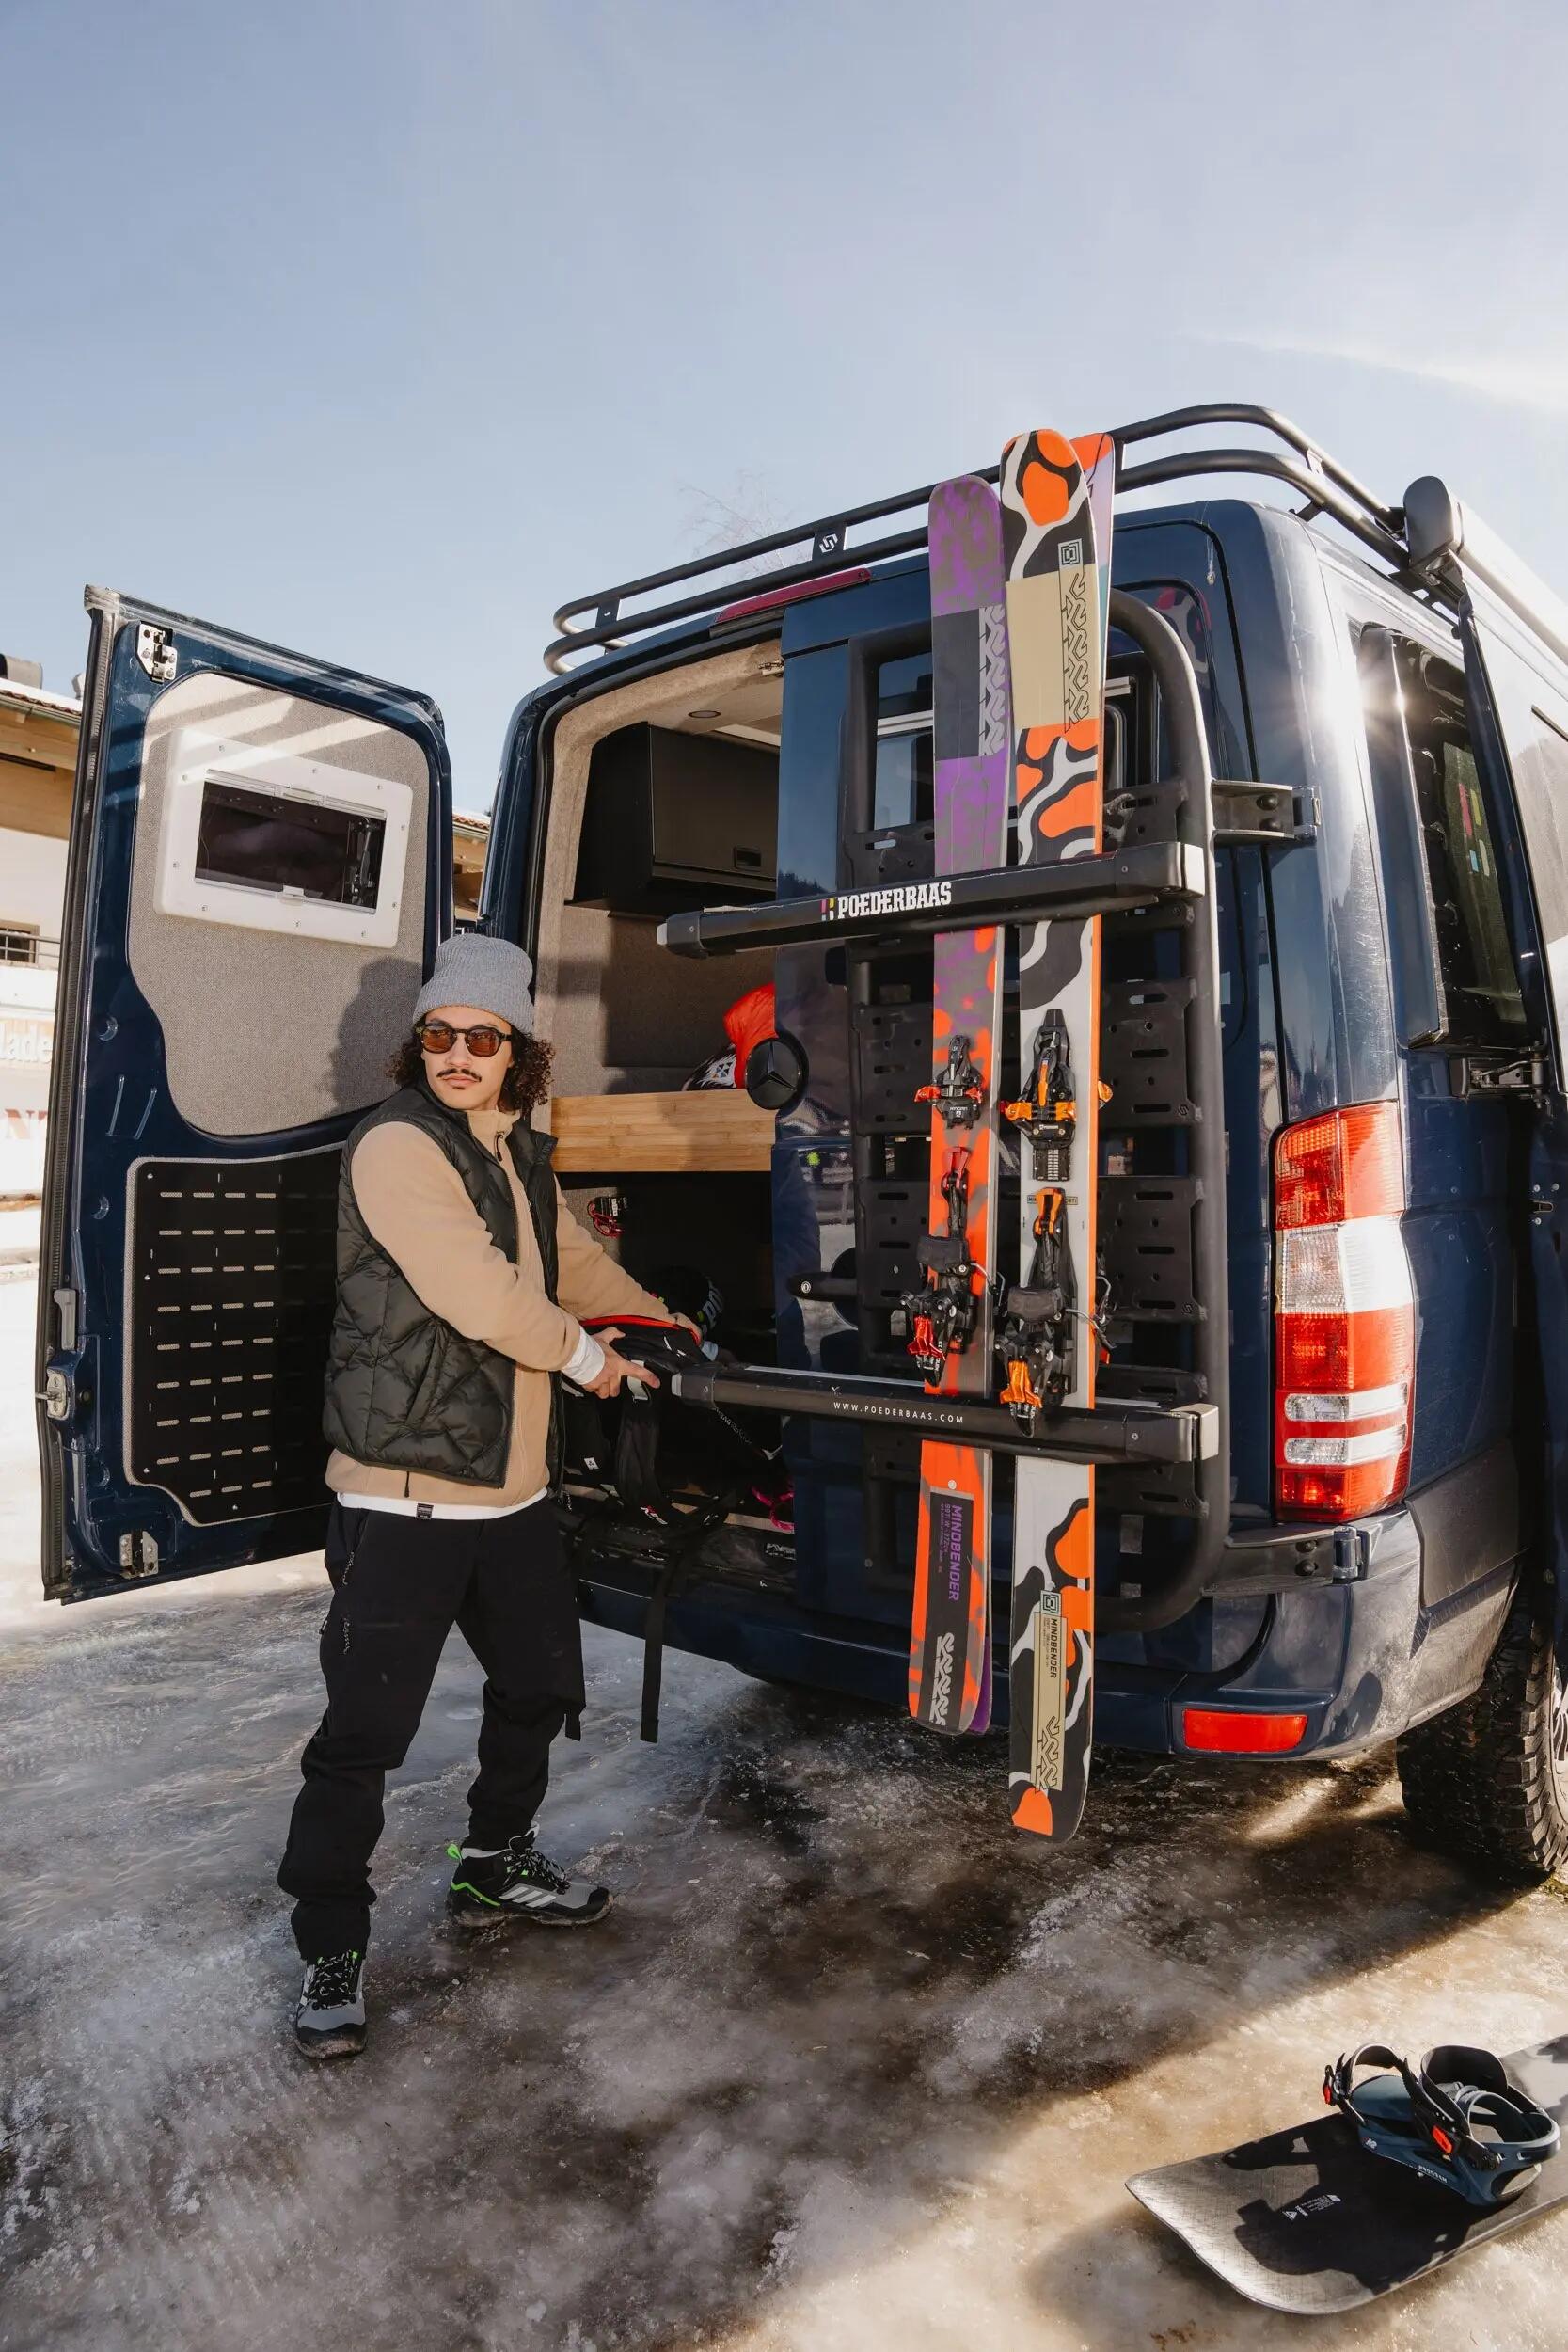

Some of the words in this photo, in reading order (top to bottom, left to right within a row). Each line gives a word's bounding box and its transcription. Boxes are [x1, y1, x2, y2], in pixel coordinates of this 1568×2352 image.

[837, 881, 952, 920] POEDERBAAS
[833, 1402, 963, 1423] WWW.POEDERBAAS.COM
[949, 1505, 963, 1602] MINDBENDER
[1050, 1618, 1058, 1678] MINDBENDER
